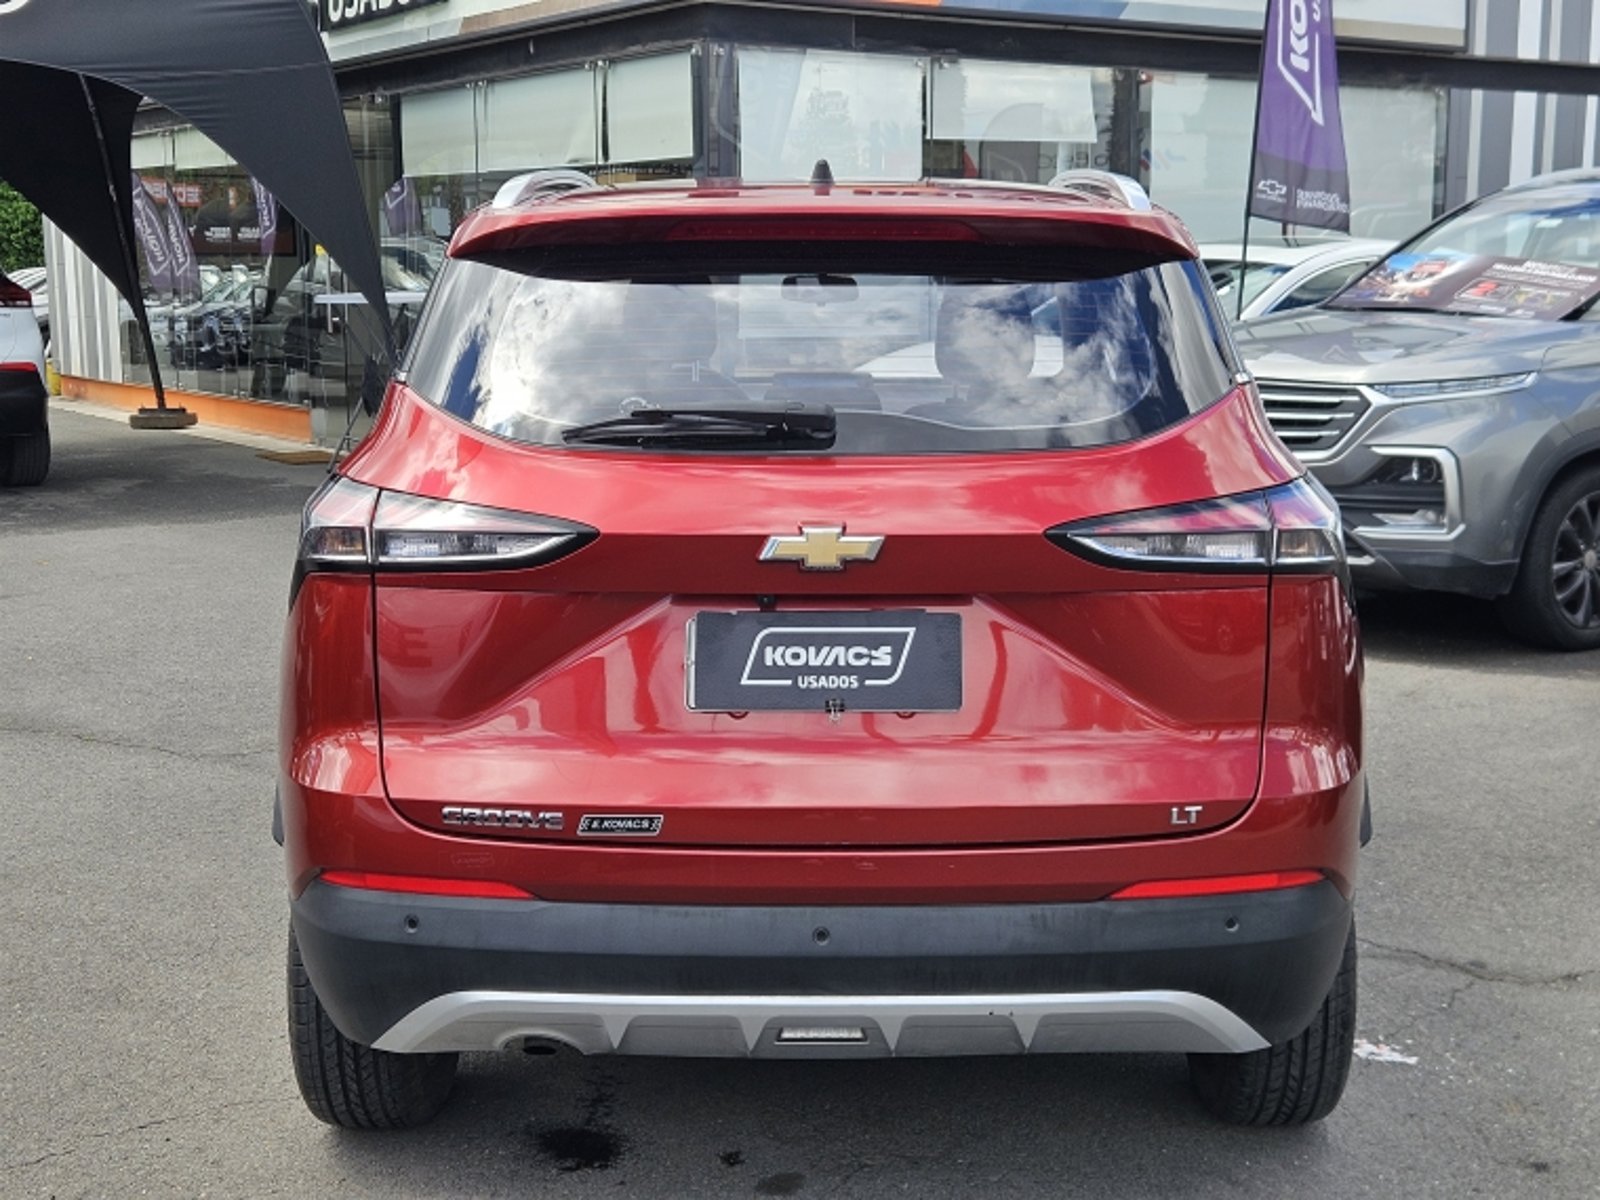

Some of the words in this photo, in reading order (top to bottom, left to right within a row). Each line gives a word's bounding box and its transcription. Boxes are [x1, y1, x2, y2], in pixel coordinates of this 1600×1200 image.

[764, 646, 892, 667] KOVACS
[797, 675, 860, 689] USADOS
[441, 806, 564, 830] GROOVE
[1171, 805, 1203, 824] LT
